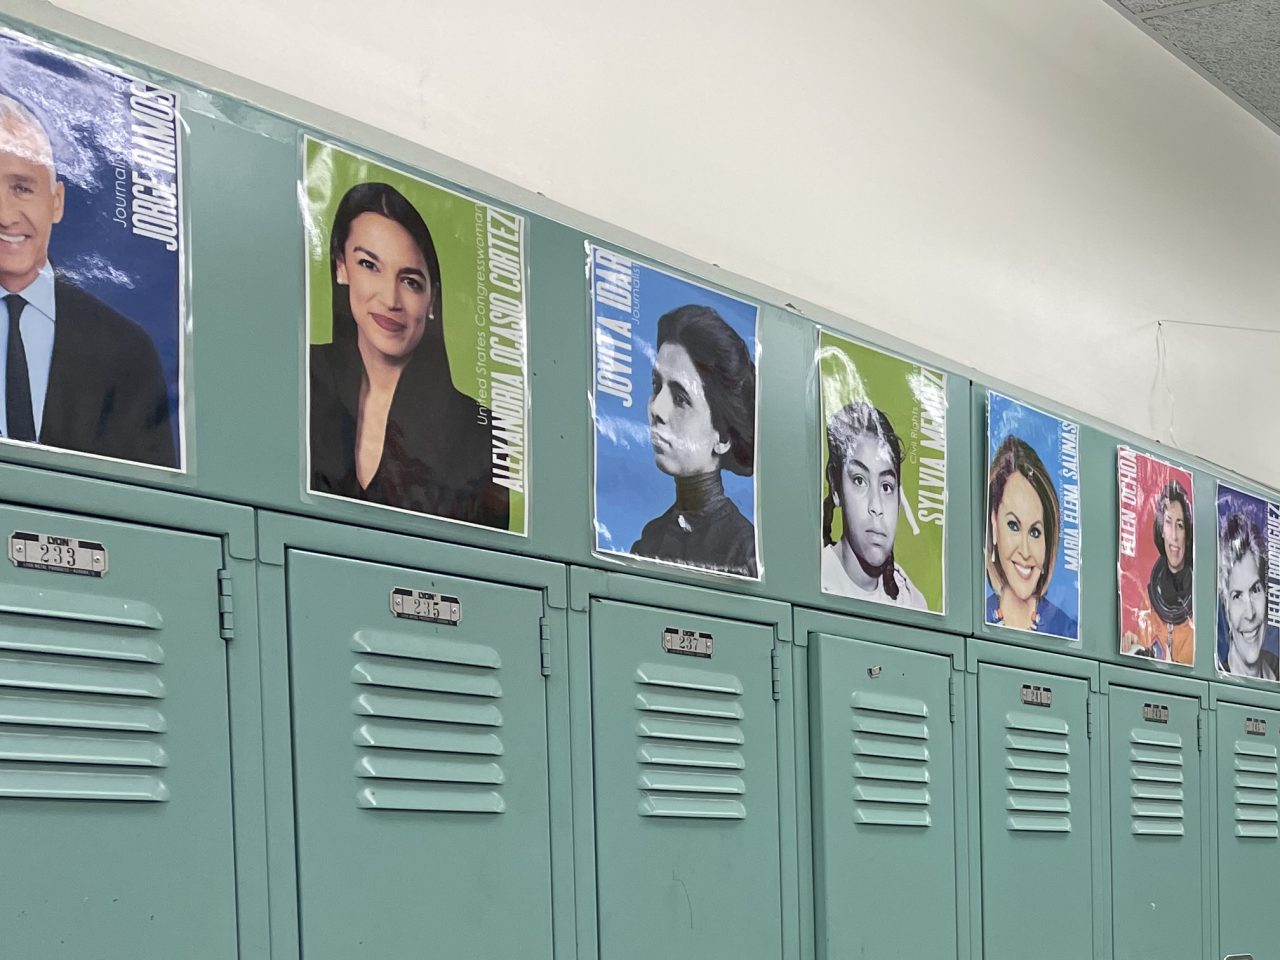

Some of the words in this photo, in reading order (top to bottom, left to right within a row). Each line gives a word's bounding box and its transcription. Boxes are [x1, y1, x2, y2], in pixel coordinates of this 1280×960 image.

[130, 81, 177, 175] RAMOS
[132, 171, 178, 251] JORGE
[475, 203, 488, 327] Congresswoman
[487, 207, 521, 293] CORTEZ
[596, 248, 632, 314] IDAR
[632, 263, 640, 325] Journalist
[476, 331, 486, 375] States
[489, 292, 524, 368] OCASIO
[596, 315, 633, 408] JOVITA
[477, 379, 487, 425] United
[490, 371, 524, 493] ALEXANDRIA
[1062, 421, 1078, 480] SALINAS
[1120, 448, 1137, 507] OCHOA
[918, 457, 945, 526] SYLVIA
[1063, 484, 1079, 524] ELENA
[40, 543, 76, 567] 233
[1268, 501, 1280, 580] RODRIGUEZ
[414, 598, 440, 618] 235
[1268, 580, 1280, 627] HELEN
[679, 635, 700, 651] 237
